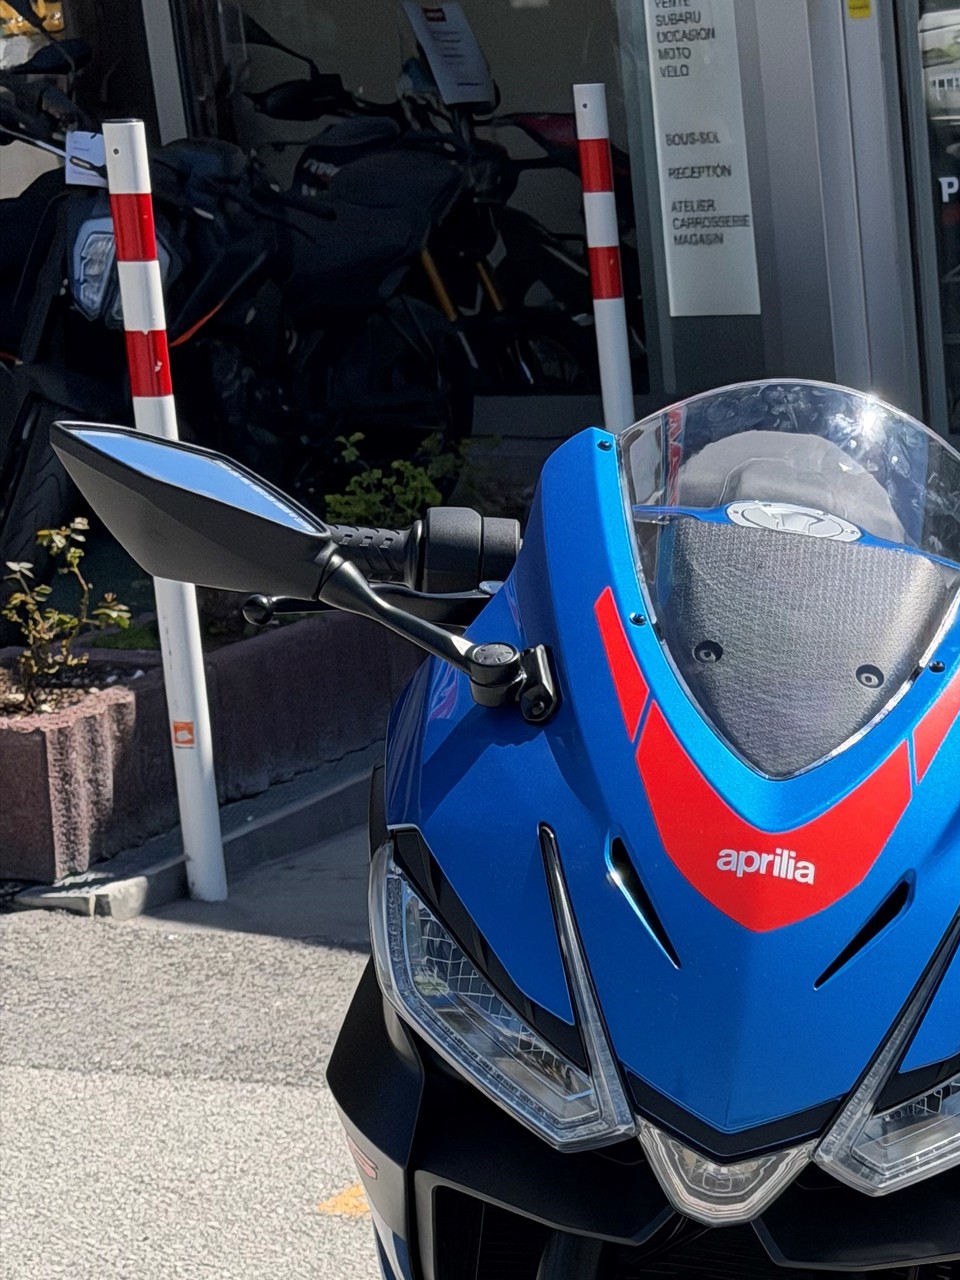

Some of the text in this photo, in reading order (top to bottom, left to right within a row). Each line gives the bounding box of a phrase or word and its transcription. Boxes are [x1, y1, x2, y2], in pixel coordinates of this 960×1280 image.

[655, 10, 701, 27] SUBARU
[656, 28, 716, 43] OCCASION
[658, 47, 692, 60] MOTO
[671, 199, 716, 213] ATELIER
[672, 214, 750, 230] CARROSSERIE
[673, 233, 724, 246] MAGASIN
[717, 848, 815, 885] aprilia
